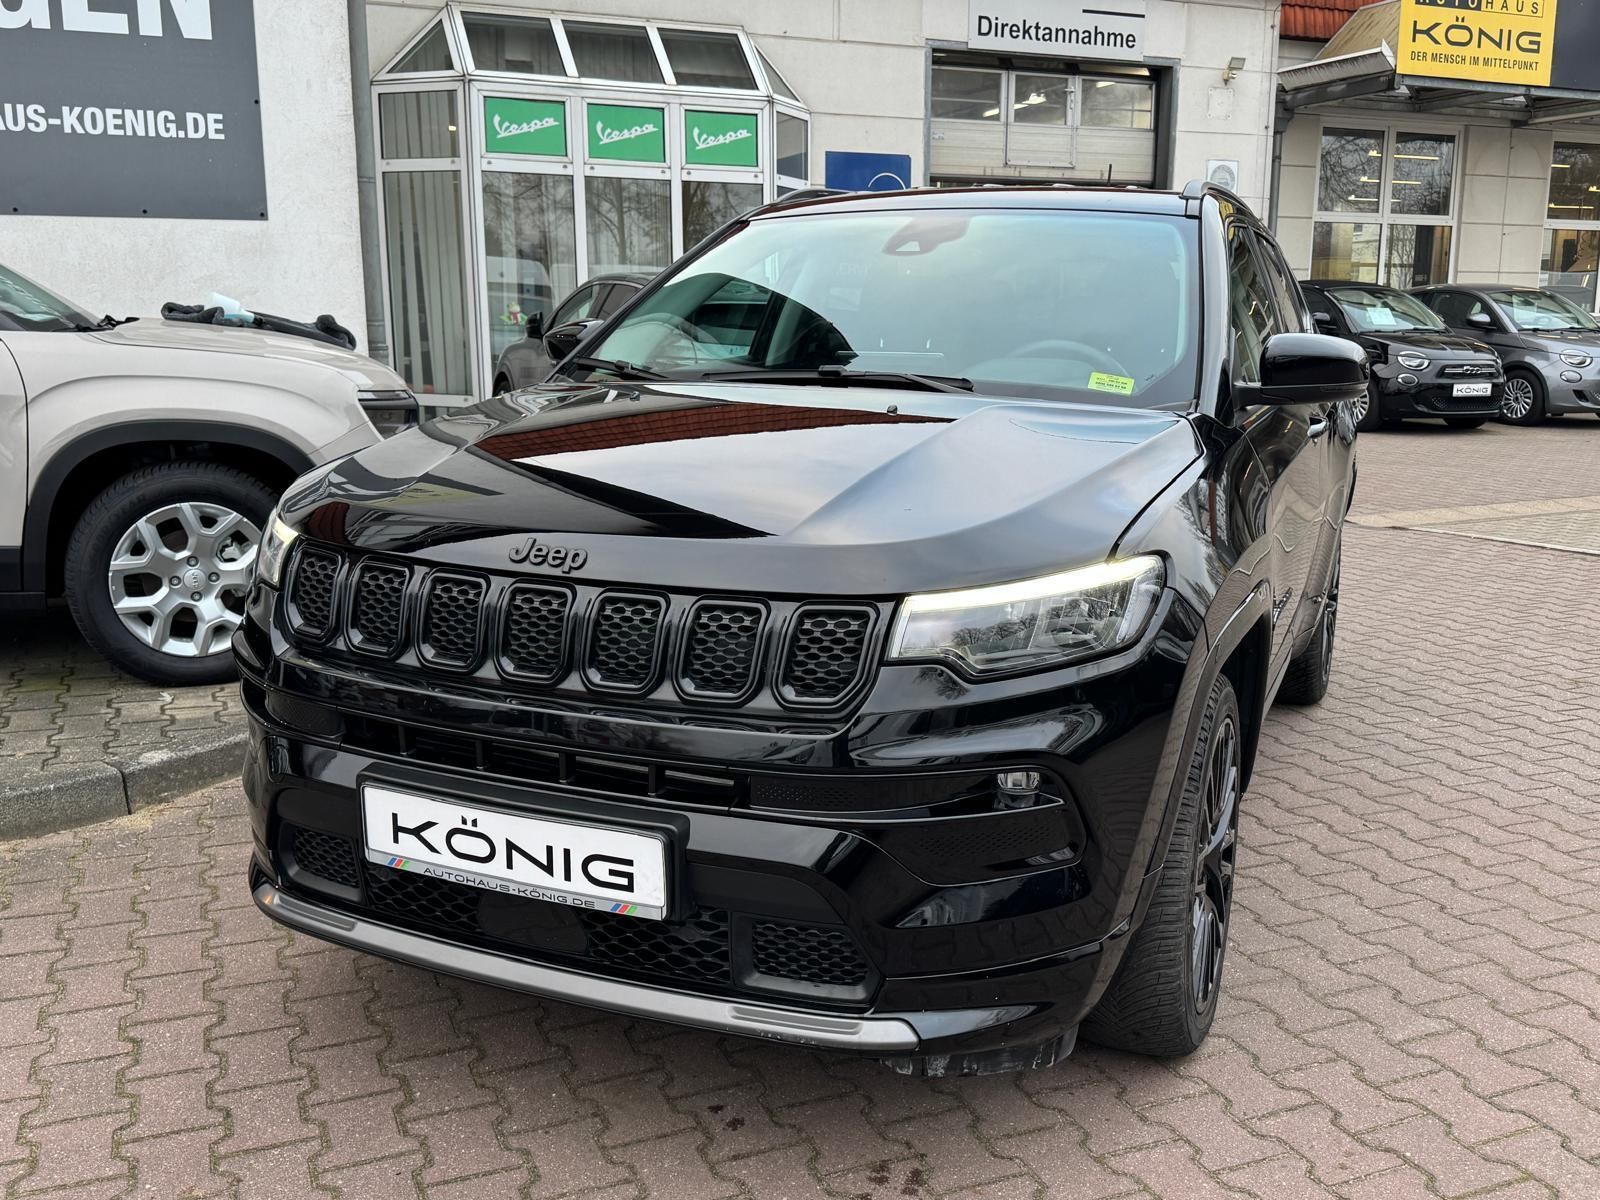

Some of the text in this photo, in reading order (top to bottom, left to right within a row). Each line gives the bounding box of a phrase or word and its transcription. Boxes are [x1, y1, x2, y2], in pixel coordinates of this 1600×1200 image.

[977, 15, 1136, 49] Direktannahme
[1411, 15, 1542, 54] KÖNIG
[1410, 51, 1539, 71] DER MENSCH IM MITTELPUNKT
[0, 103, 225, 140] US-KOENIG.DE
[493, 114, 560, 138] Vespa
[596, 121, 659, 144] Vespa
[693, 126, 752, 149] Vespa
[508, 537, 588, 574] Jeep
[391, 812, 635, 893] KÖNIG
